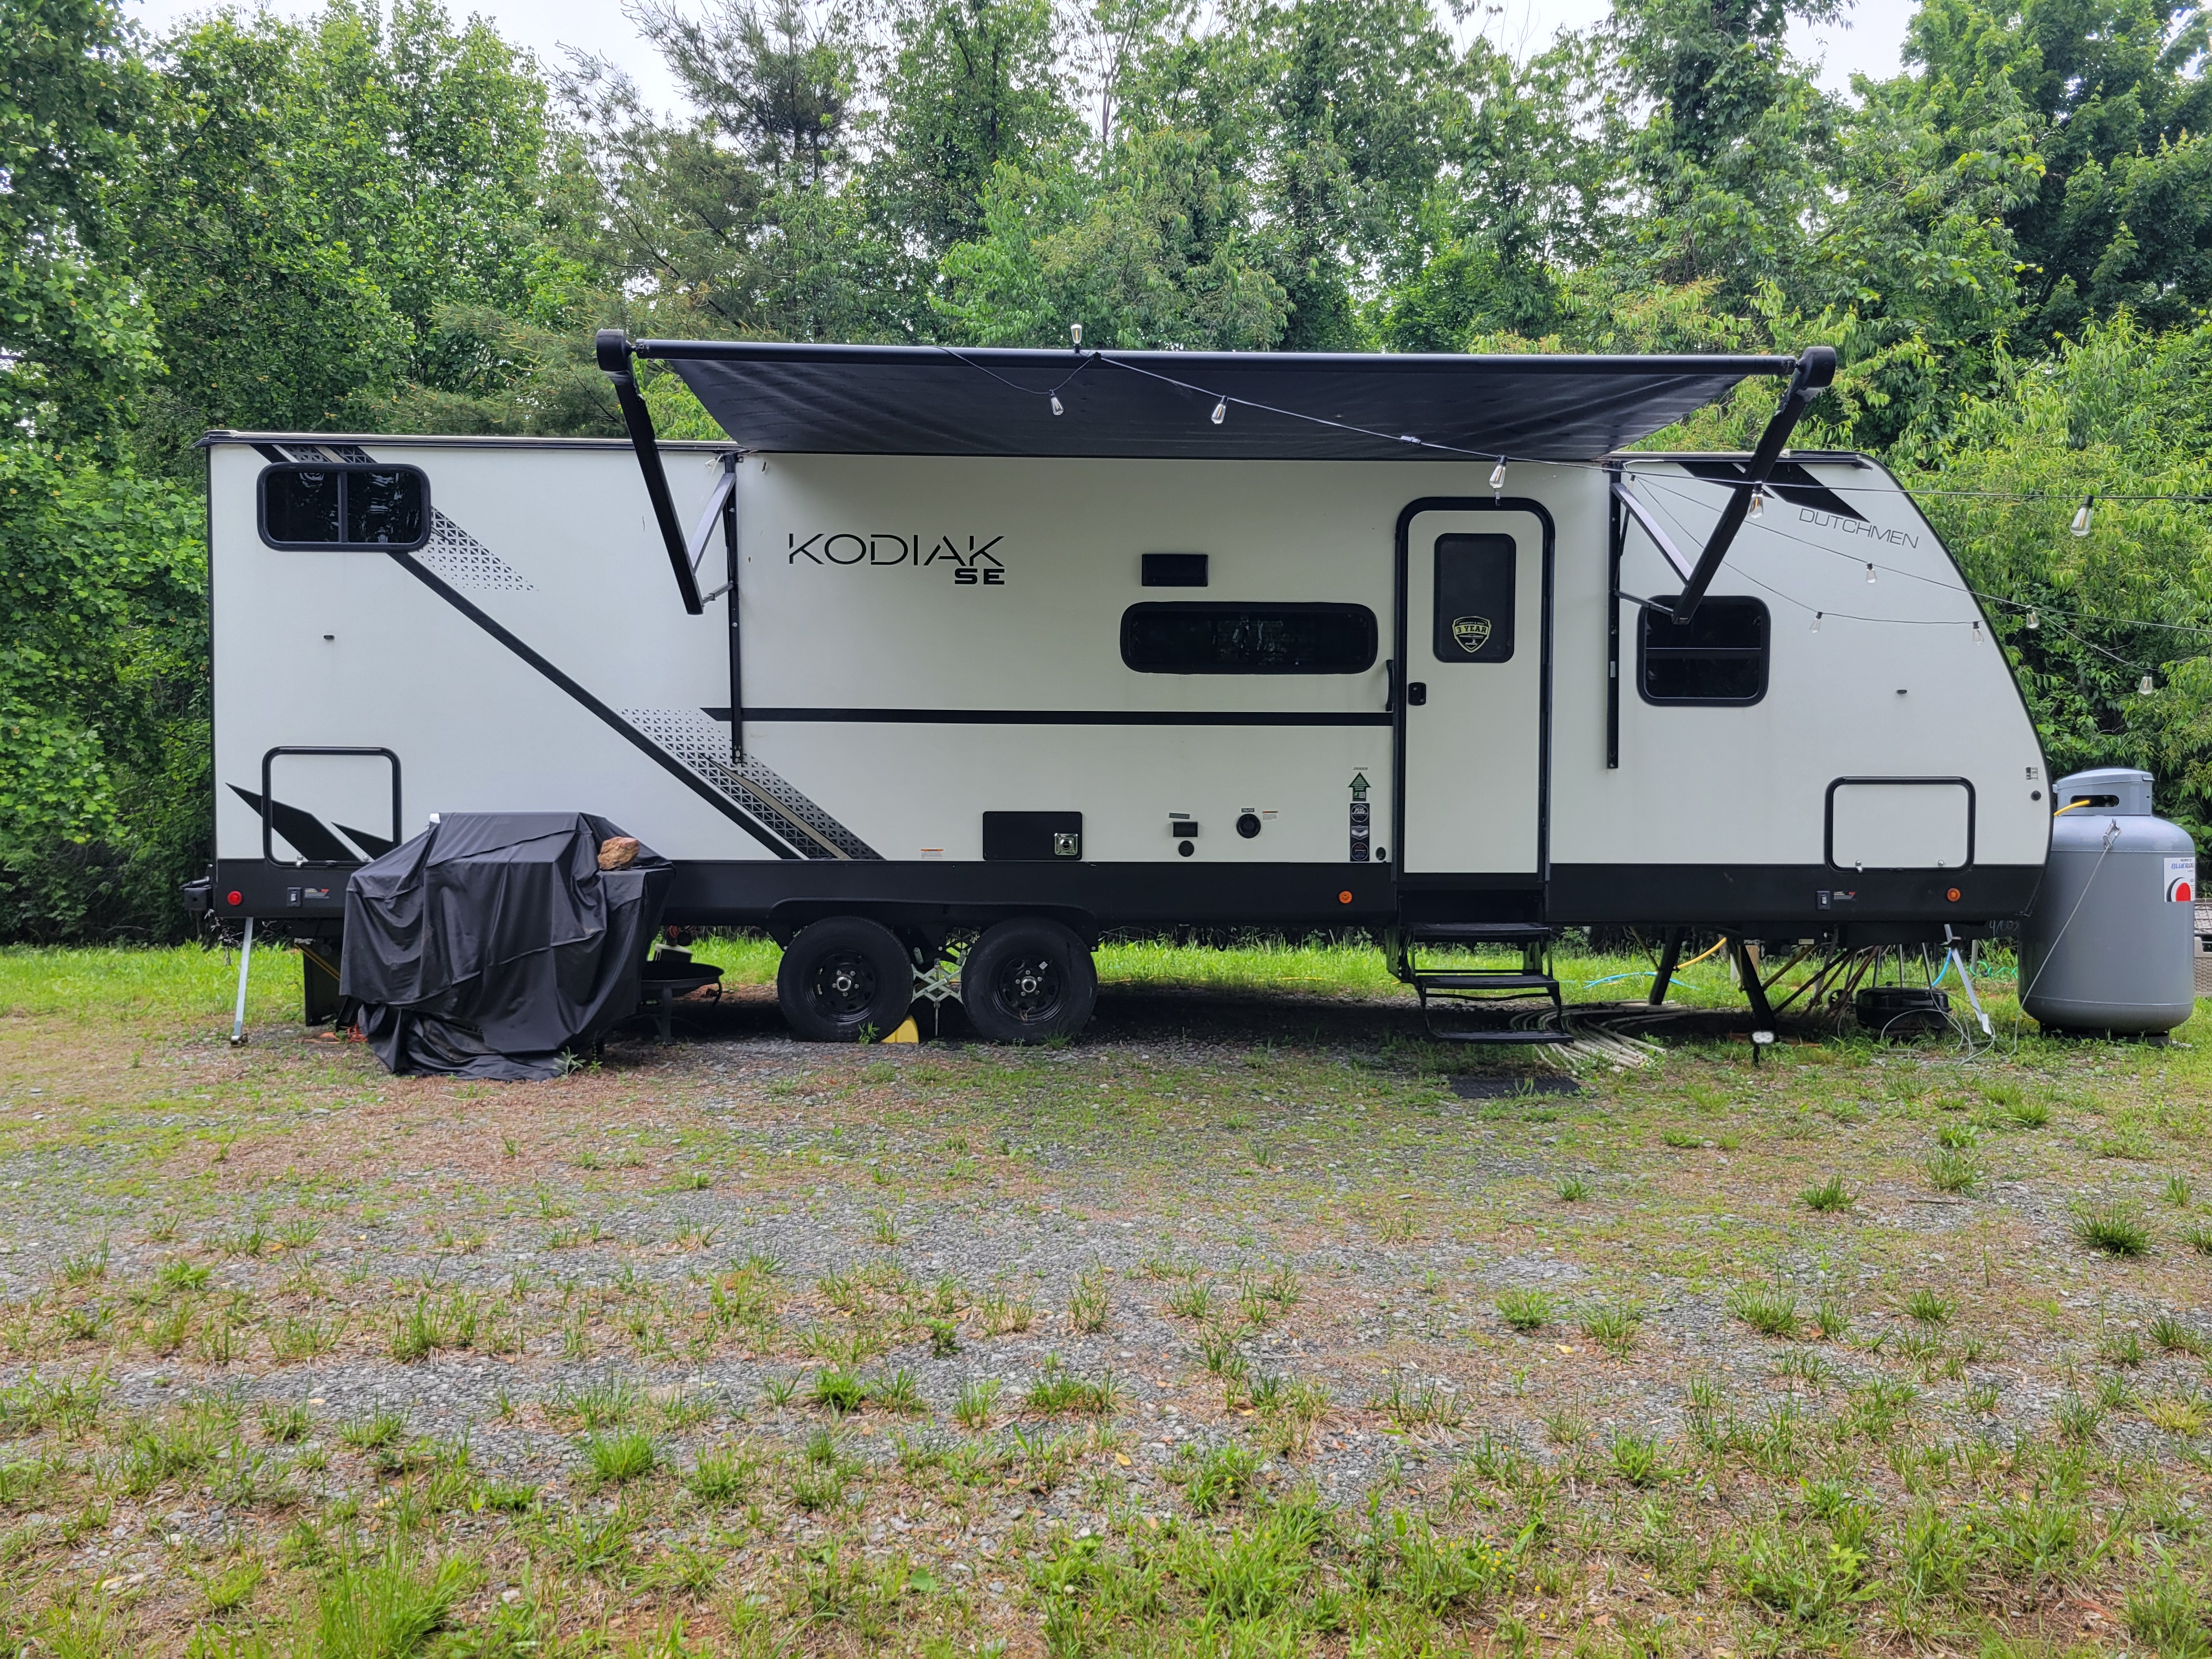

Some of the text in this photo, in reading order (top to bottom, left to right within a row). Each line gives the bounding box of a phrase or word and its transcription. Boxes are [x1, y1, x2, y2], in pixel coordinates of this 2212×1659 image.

[1798, 508, 1919, 549] DUTCHMEN
[788, 533, 1005, 567] KODIAK
[954, 568, 1005, 585] SE
